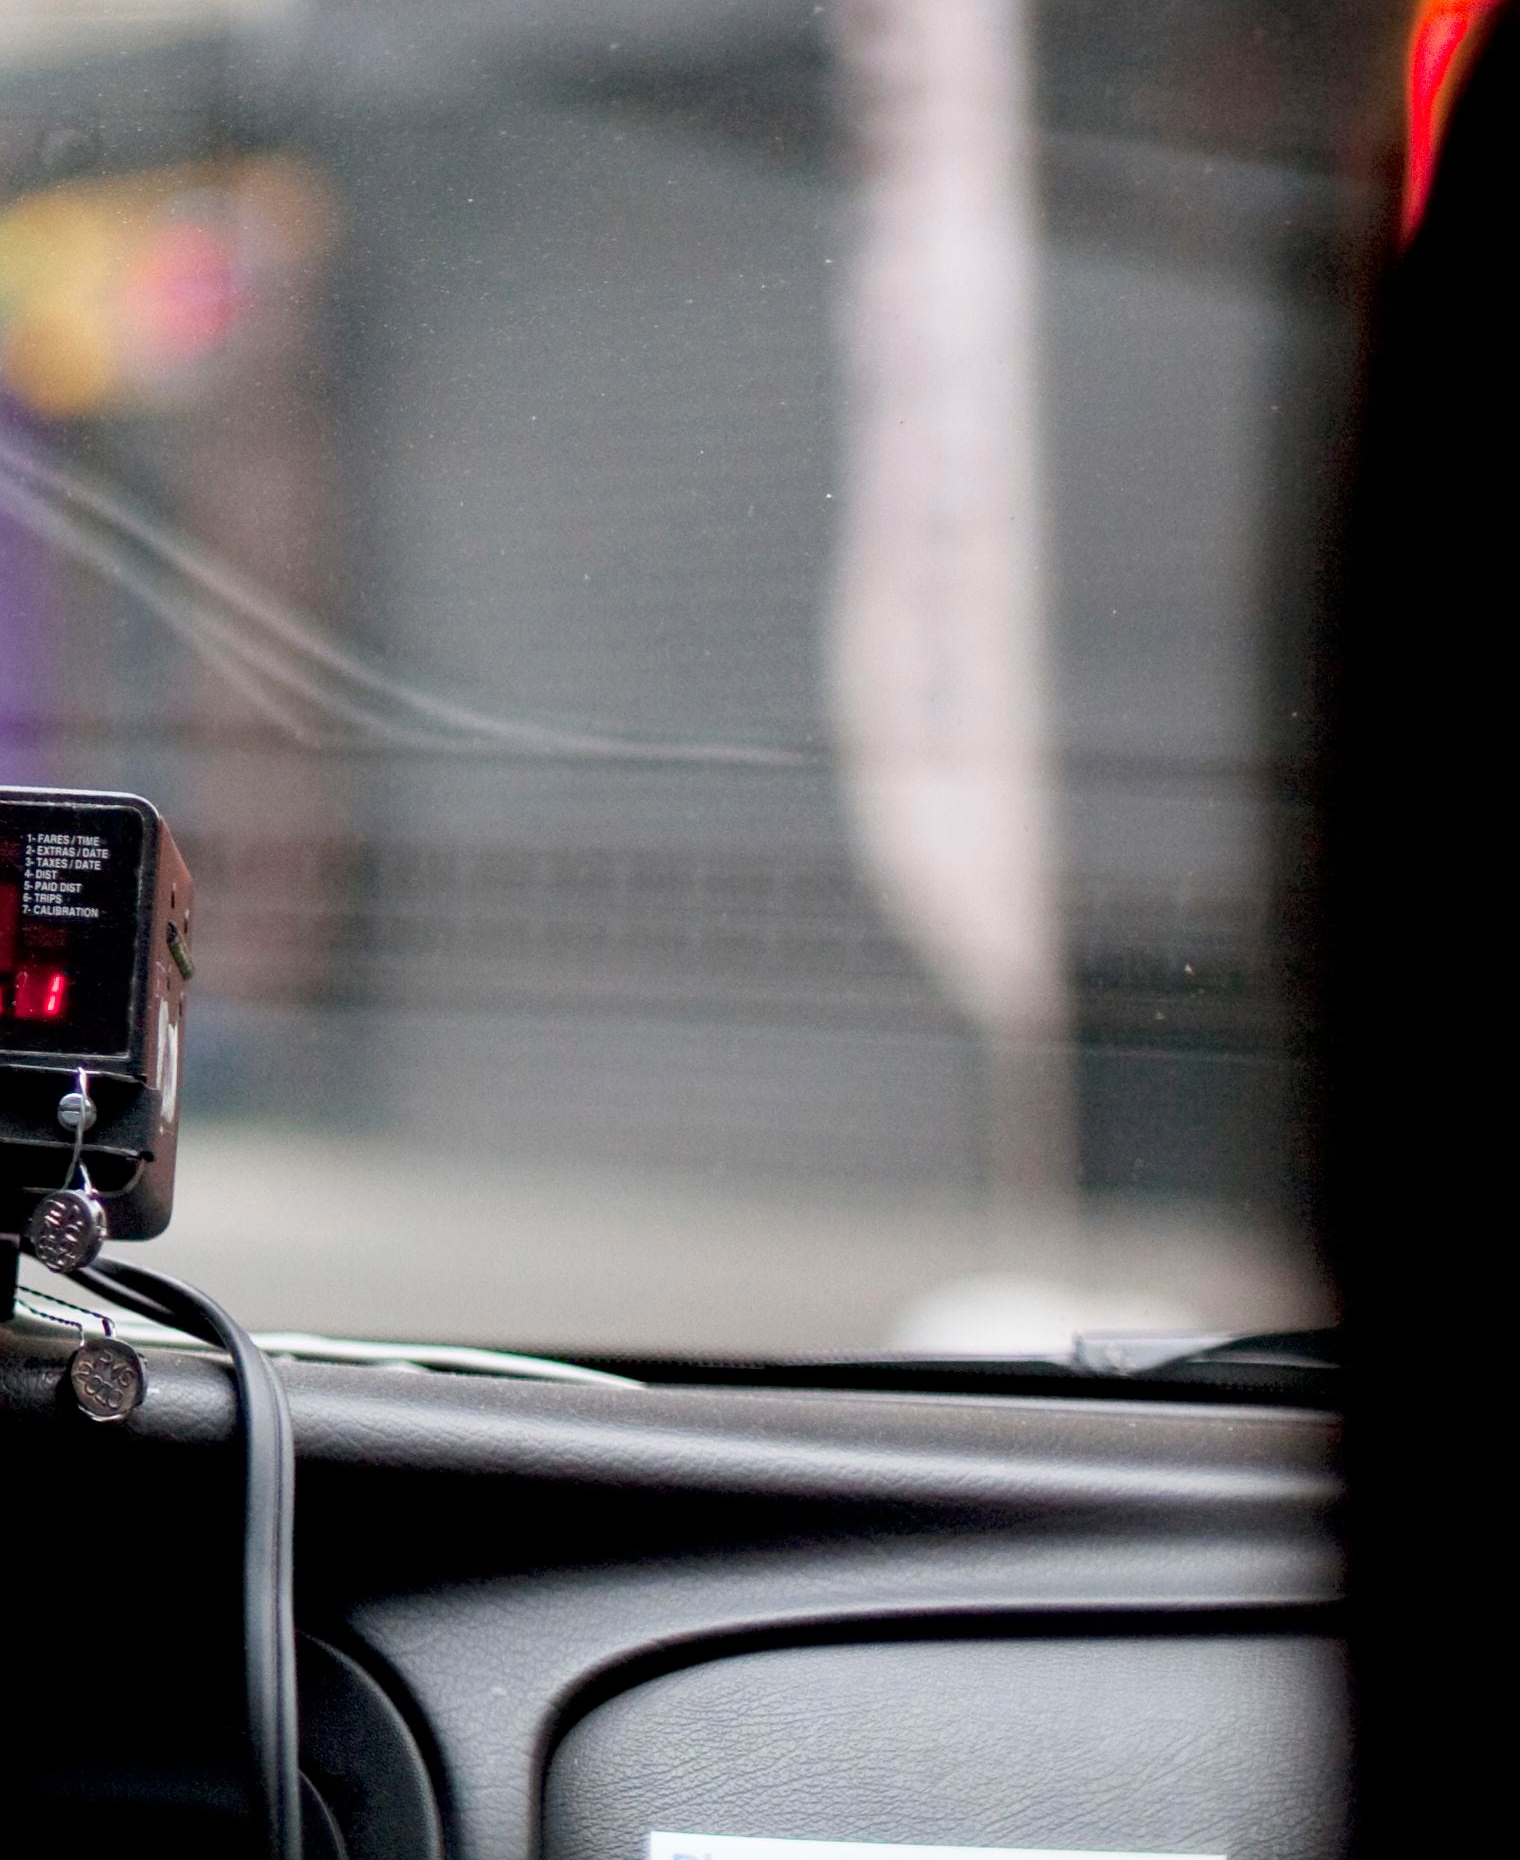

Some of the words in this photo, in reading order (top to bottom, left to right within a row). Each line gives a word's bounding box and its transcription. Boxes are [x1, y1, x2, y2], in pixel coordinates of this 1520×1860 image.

[37, 834, 70, 845] FARES
[77, 835, 100, 846] TIME
[37, 845, 75, 857] EXTRAS
[82, 848, 109, 859] DATE
[36, 857, 68, 869] TAXES
[75, 859, 102, 870] DATE
[35, 869, 57, 880] DIST
[35, 881, 58, 892] PAID
[59, 882, 82, 893] DIST
[34, 893, 63, 904] TRIPS
[33, 905, 99, 918] CALIBRATION
